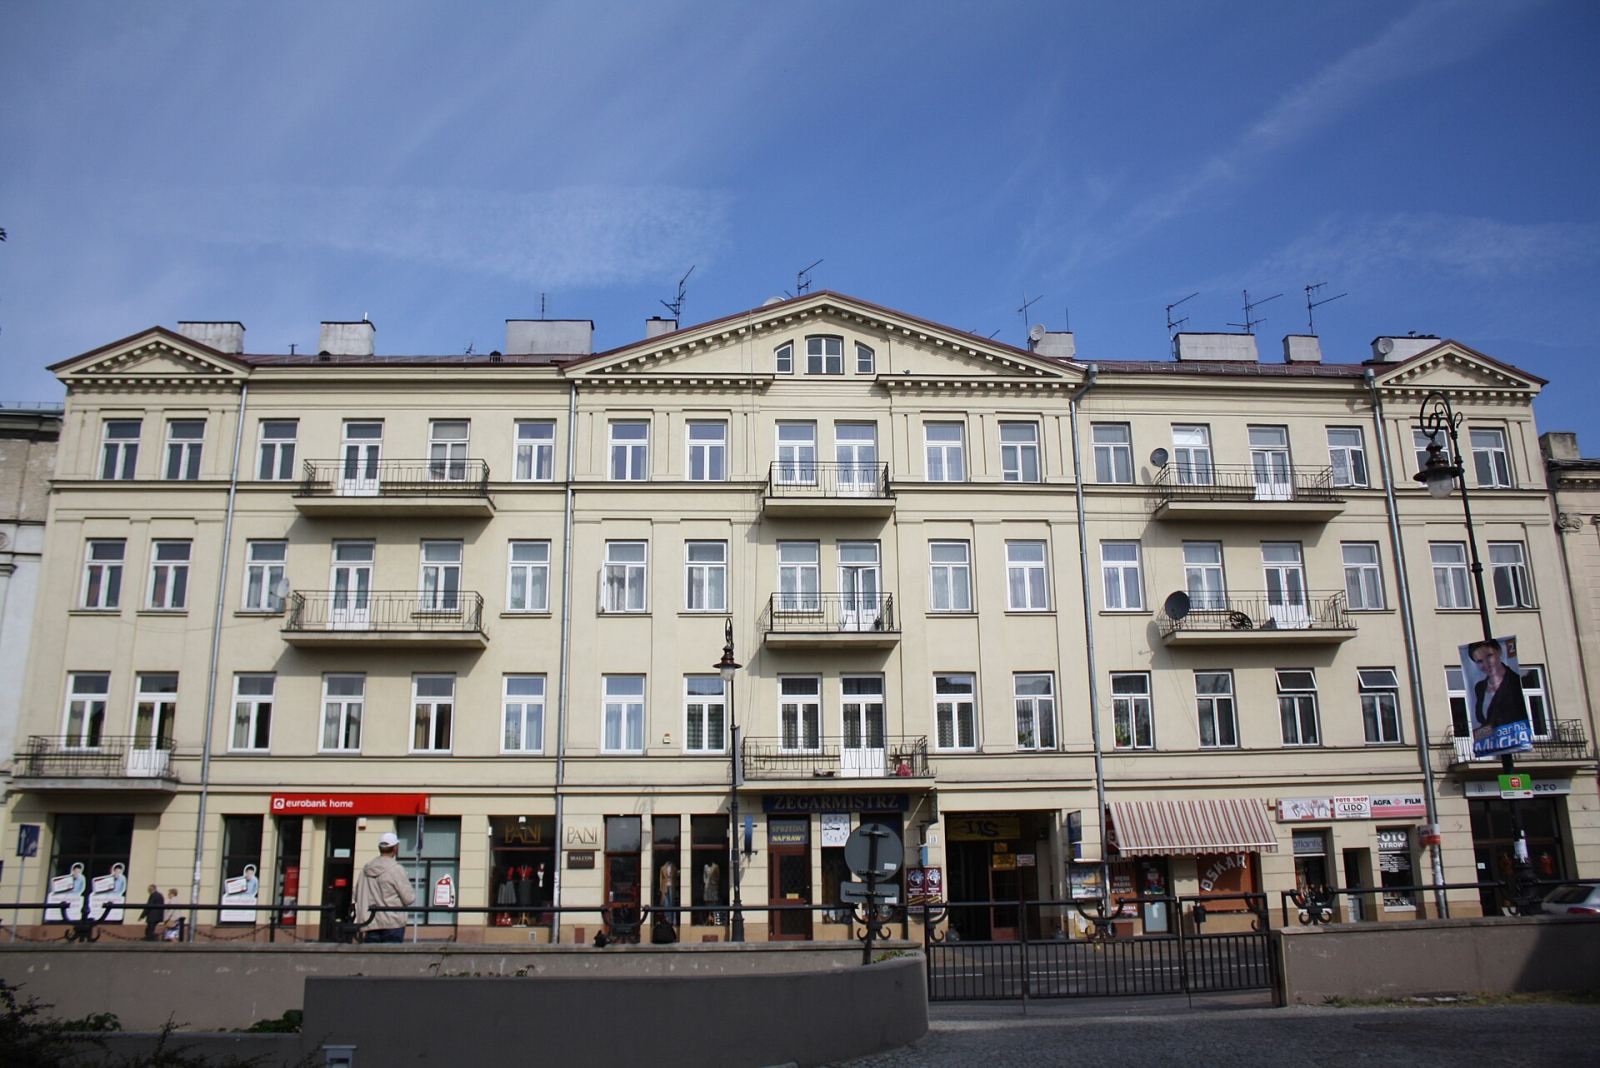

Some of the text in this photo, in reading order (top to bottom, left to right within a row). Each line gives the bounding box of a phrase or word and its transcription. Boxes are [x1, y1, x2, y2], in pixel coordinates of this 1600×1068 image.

[285, 798, 354, 808] eurobank home
[774, 794, 899, 809] ZEGARMISTRZ
[567, 826, 598, 844] PANI
[1200, 854, 1247, 892] OSKAR
